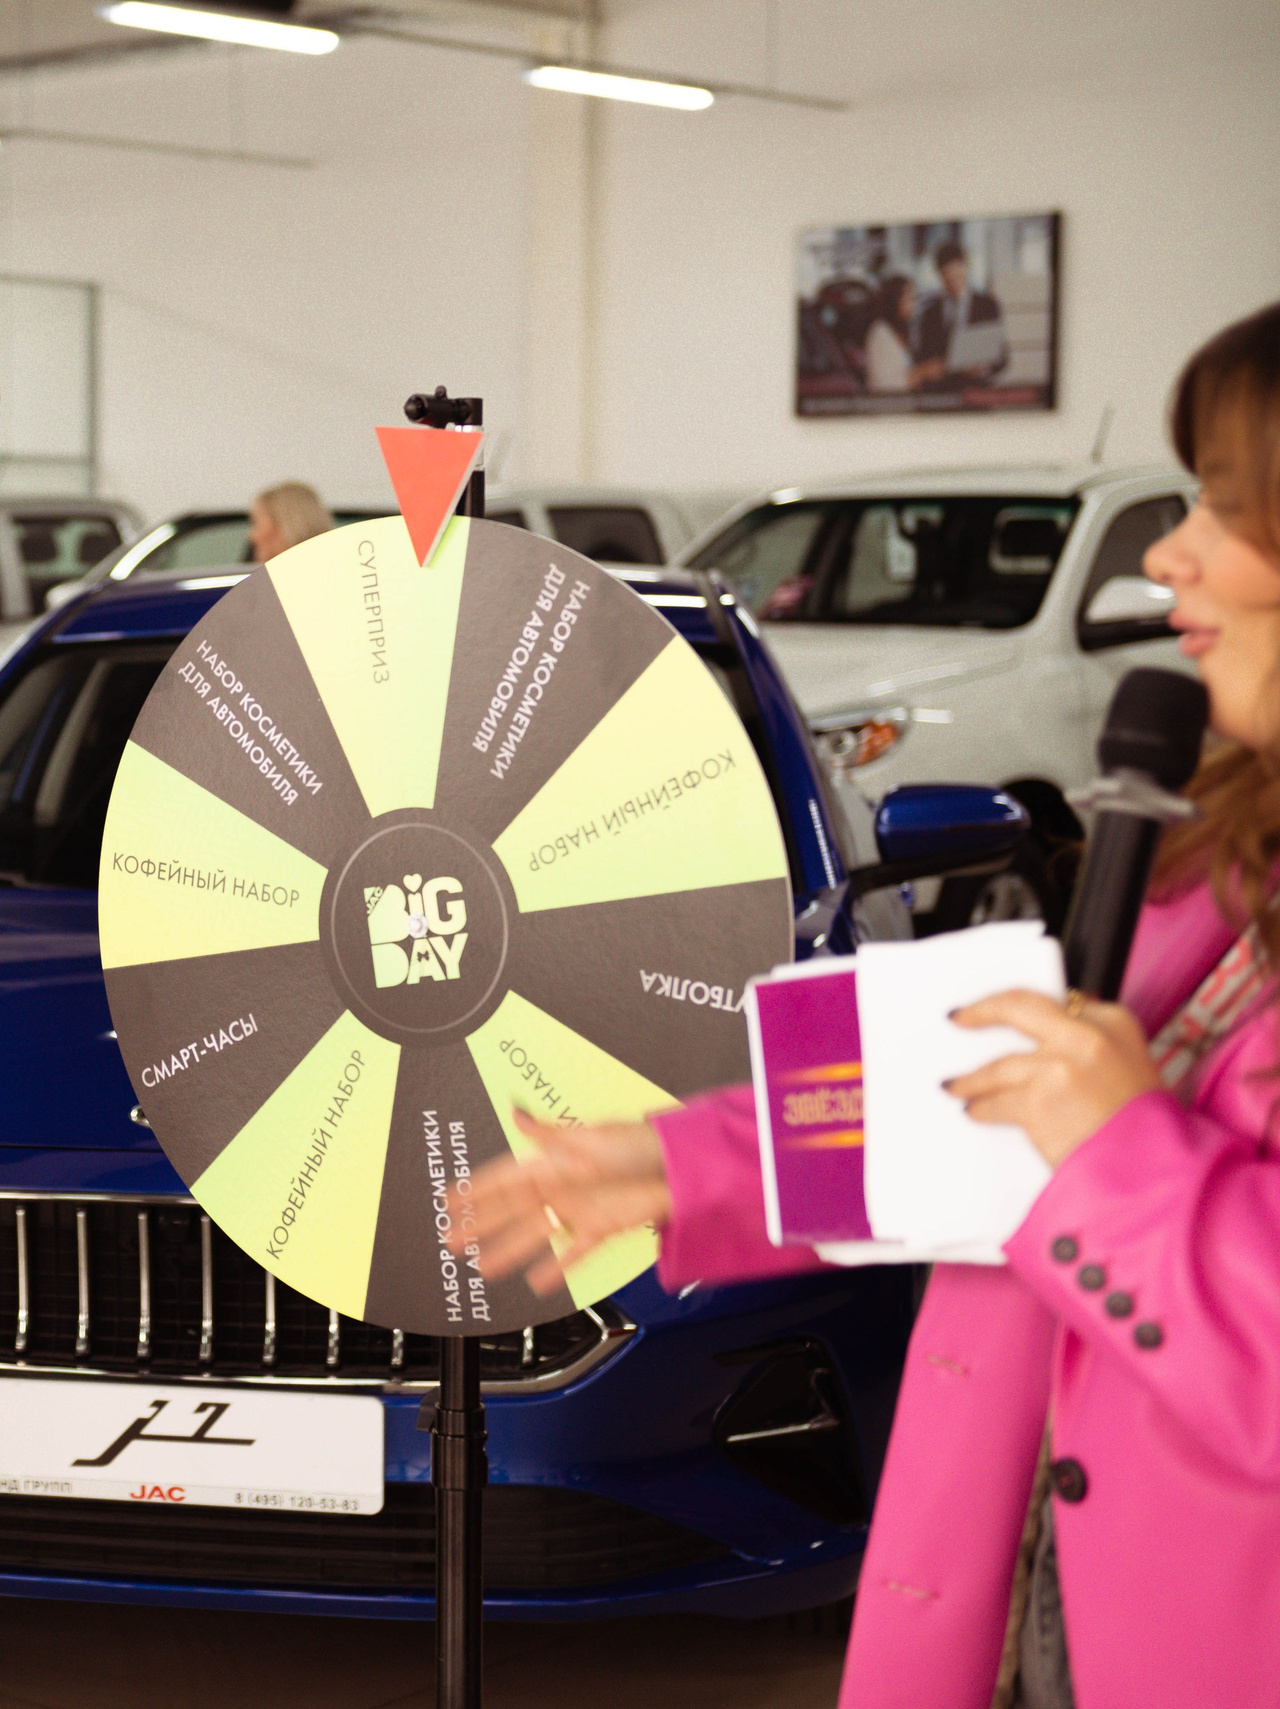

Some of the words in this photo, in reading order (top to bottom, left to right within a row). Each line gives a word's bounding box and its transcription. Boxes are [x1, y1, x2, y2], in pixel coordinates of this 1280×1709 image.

[357, 540, 390, 684] СУПЕРПРИЗ
[536, 562, 566, 613] ДЛЯ
[549, 580, 591, 654] НАБОР
[196, 639, 244, 696] НАБОР
[239, 692, 324, 795] КОСМЕТИКИ
[472, 610, 544, 753] АВТОМОБИЛЯ
[489, 652, 558, 780] КОСМЕТИКИ
[177, 660, 212, 699] ДЛЯ
[206, 696, 299, 807] АВТОМОБИЛЯ
[601, 749, 737, 836] КОФЕЙНЫЙ
[113, 851, 227, 894] КОФЕЙНЫЙ
[232, 877, 301, 908] НАБОР
[528, 820, 601, 872] НАБОР
[371, 932, 469, 989] DAY
[141, 1013, 259, 1088] СМАРТ-ЧАСЫ
[499, 1039, 562, 1109] НАБОР
[266, 1127, 333, 1260] КОФЕЙНЫЙ
[324, 1049, 366, 1127] НАБОР
[422, 1109, 453, 1245] КОСМЕТИКИ
[439, 1248, 463, 1322] НАБОР
[468, 1277, 492, 1322] ДЛЯ
[23, 1480, 73, 1493] ГРУПП
[129, 1484, 186, 1502] JAC
[248, 1492, 284, 1508] (495)
